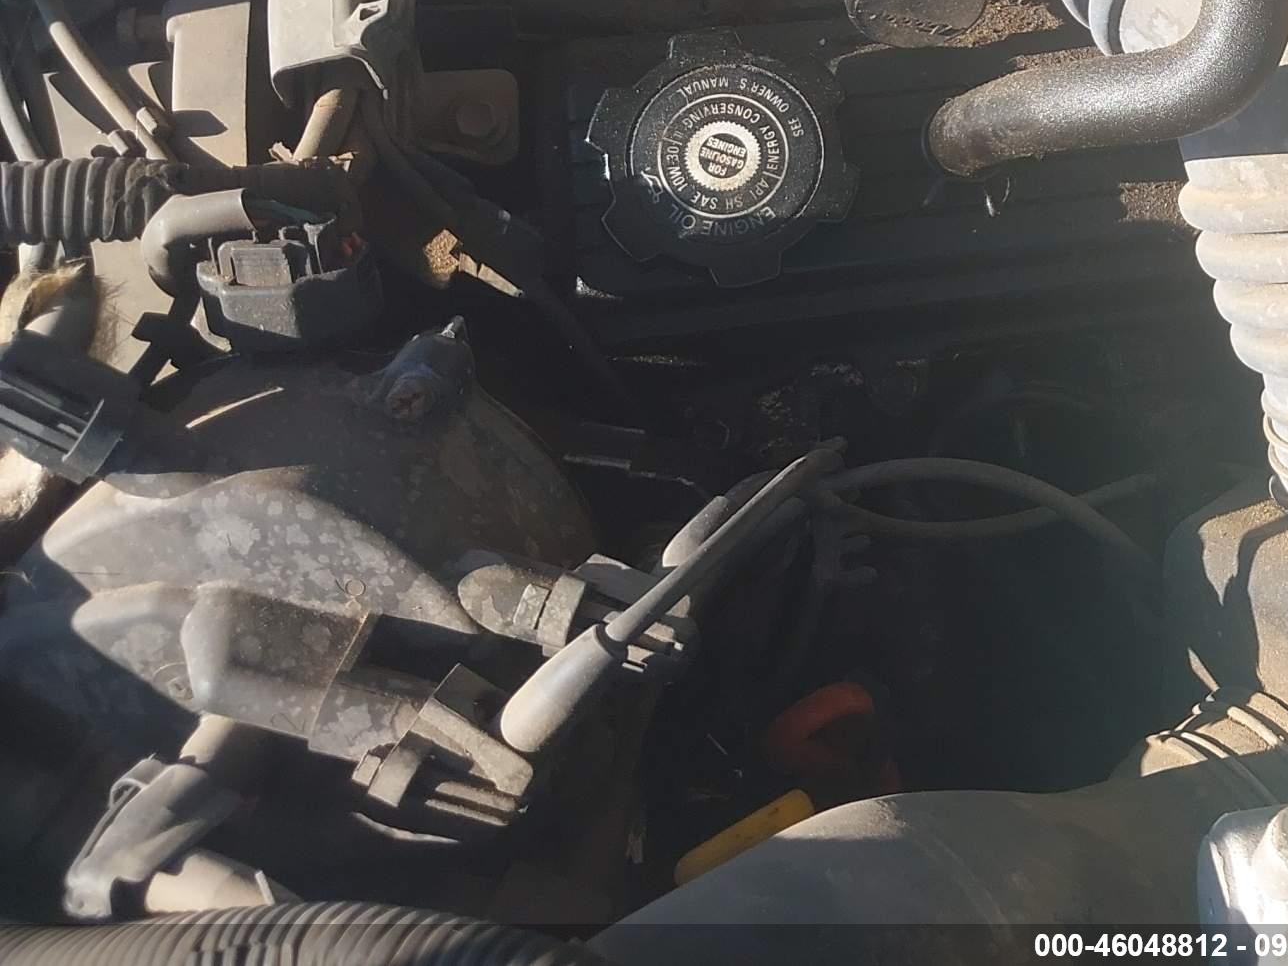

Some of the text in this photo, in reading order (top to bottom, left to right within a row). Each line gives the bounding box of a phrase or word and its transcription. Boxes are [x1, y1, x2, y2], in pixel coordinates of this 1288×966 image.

[676, 76, 730, 97] MANUAL
[681, 102, 763, 130] CONSERVING
[700, 146, 745, 170] GASOLINE
[705, 136, 747, 158] ENGINES
[759, 124, 780, 171] ENERGY
[666, 145, 771, 210] API SH SAE 10W-30
[707, 161, 728, 176] FOR
[667, 203, 776, 236] ENGINE OIL
